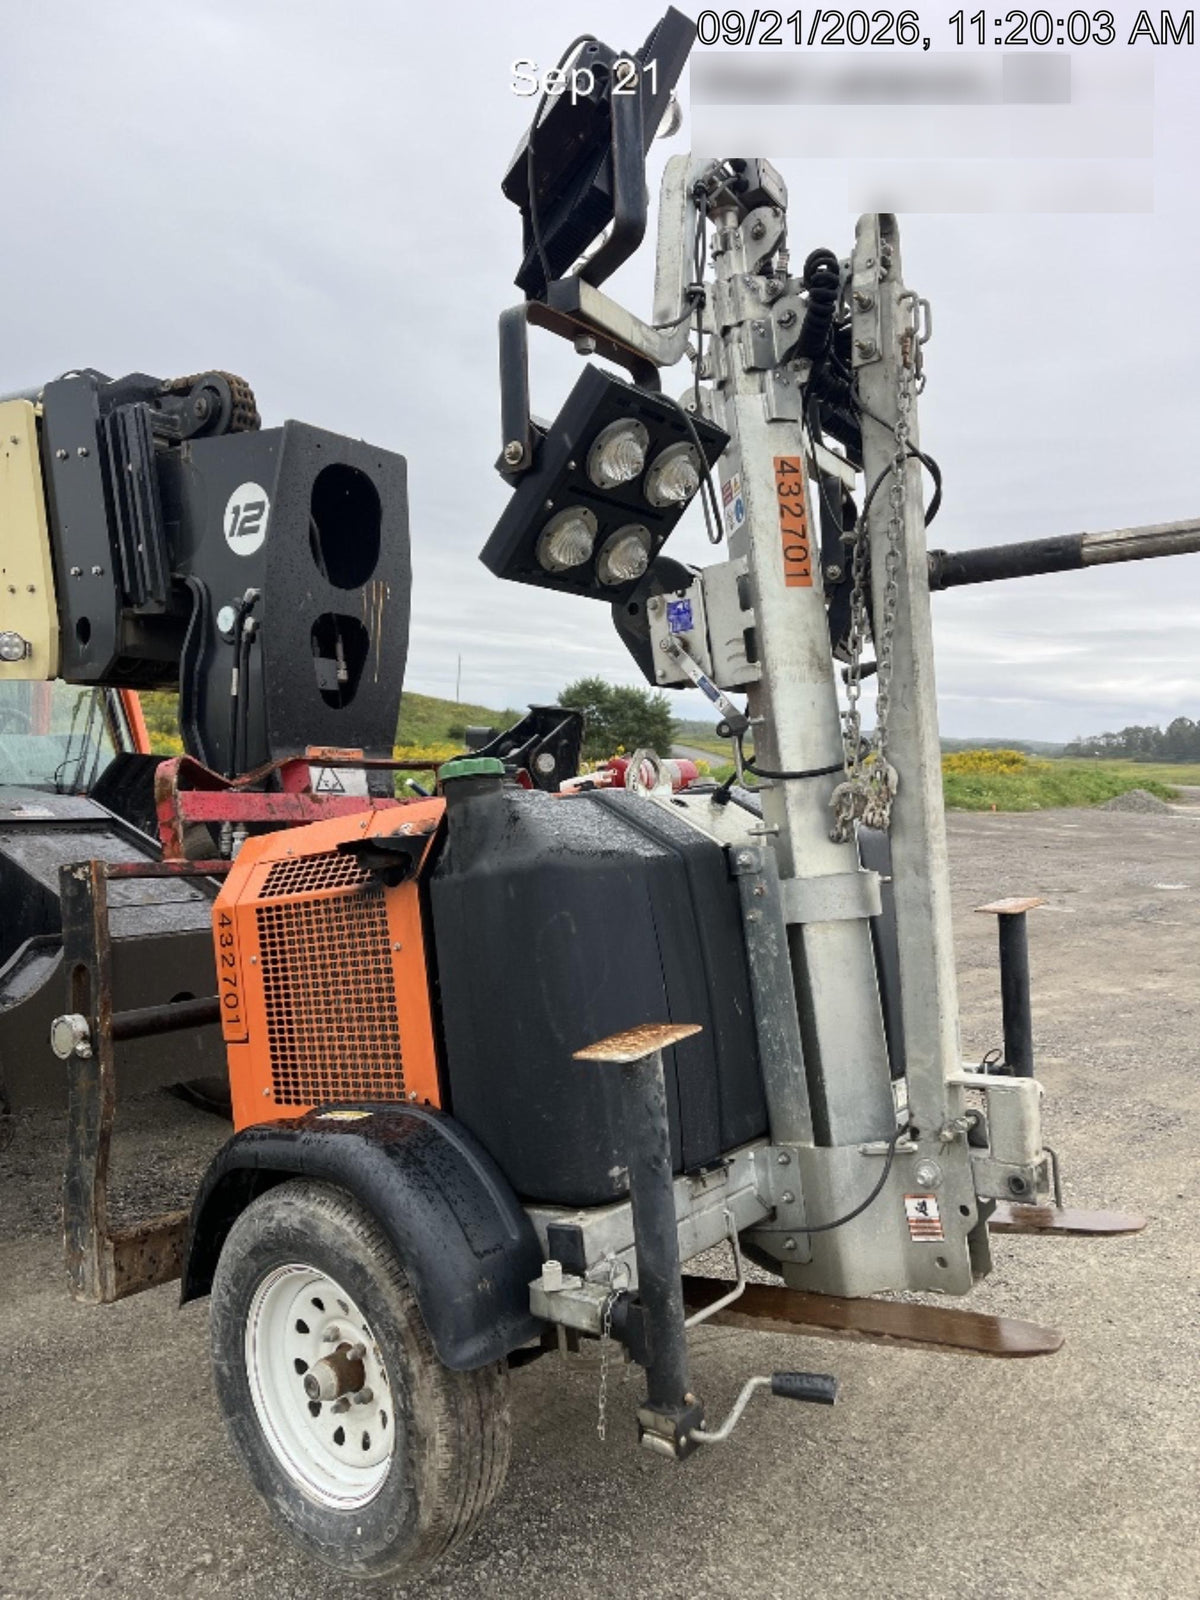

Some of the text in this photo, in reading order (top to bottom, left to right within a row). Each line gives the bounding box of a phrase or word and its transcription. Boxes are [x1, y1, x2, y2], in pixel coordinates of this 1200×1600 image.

[229, 500, 265, 537] 12
[776, 460, 810, 577] 432701
[218, 913, 241, 1024] 432701
